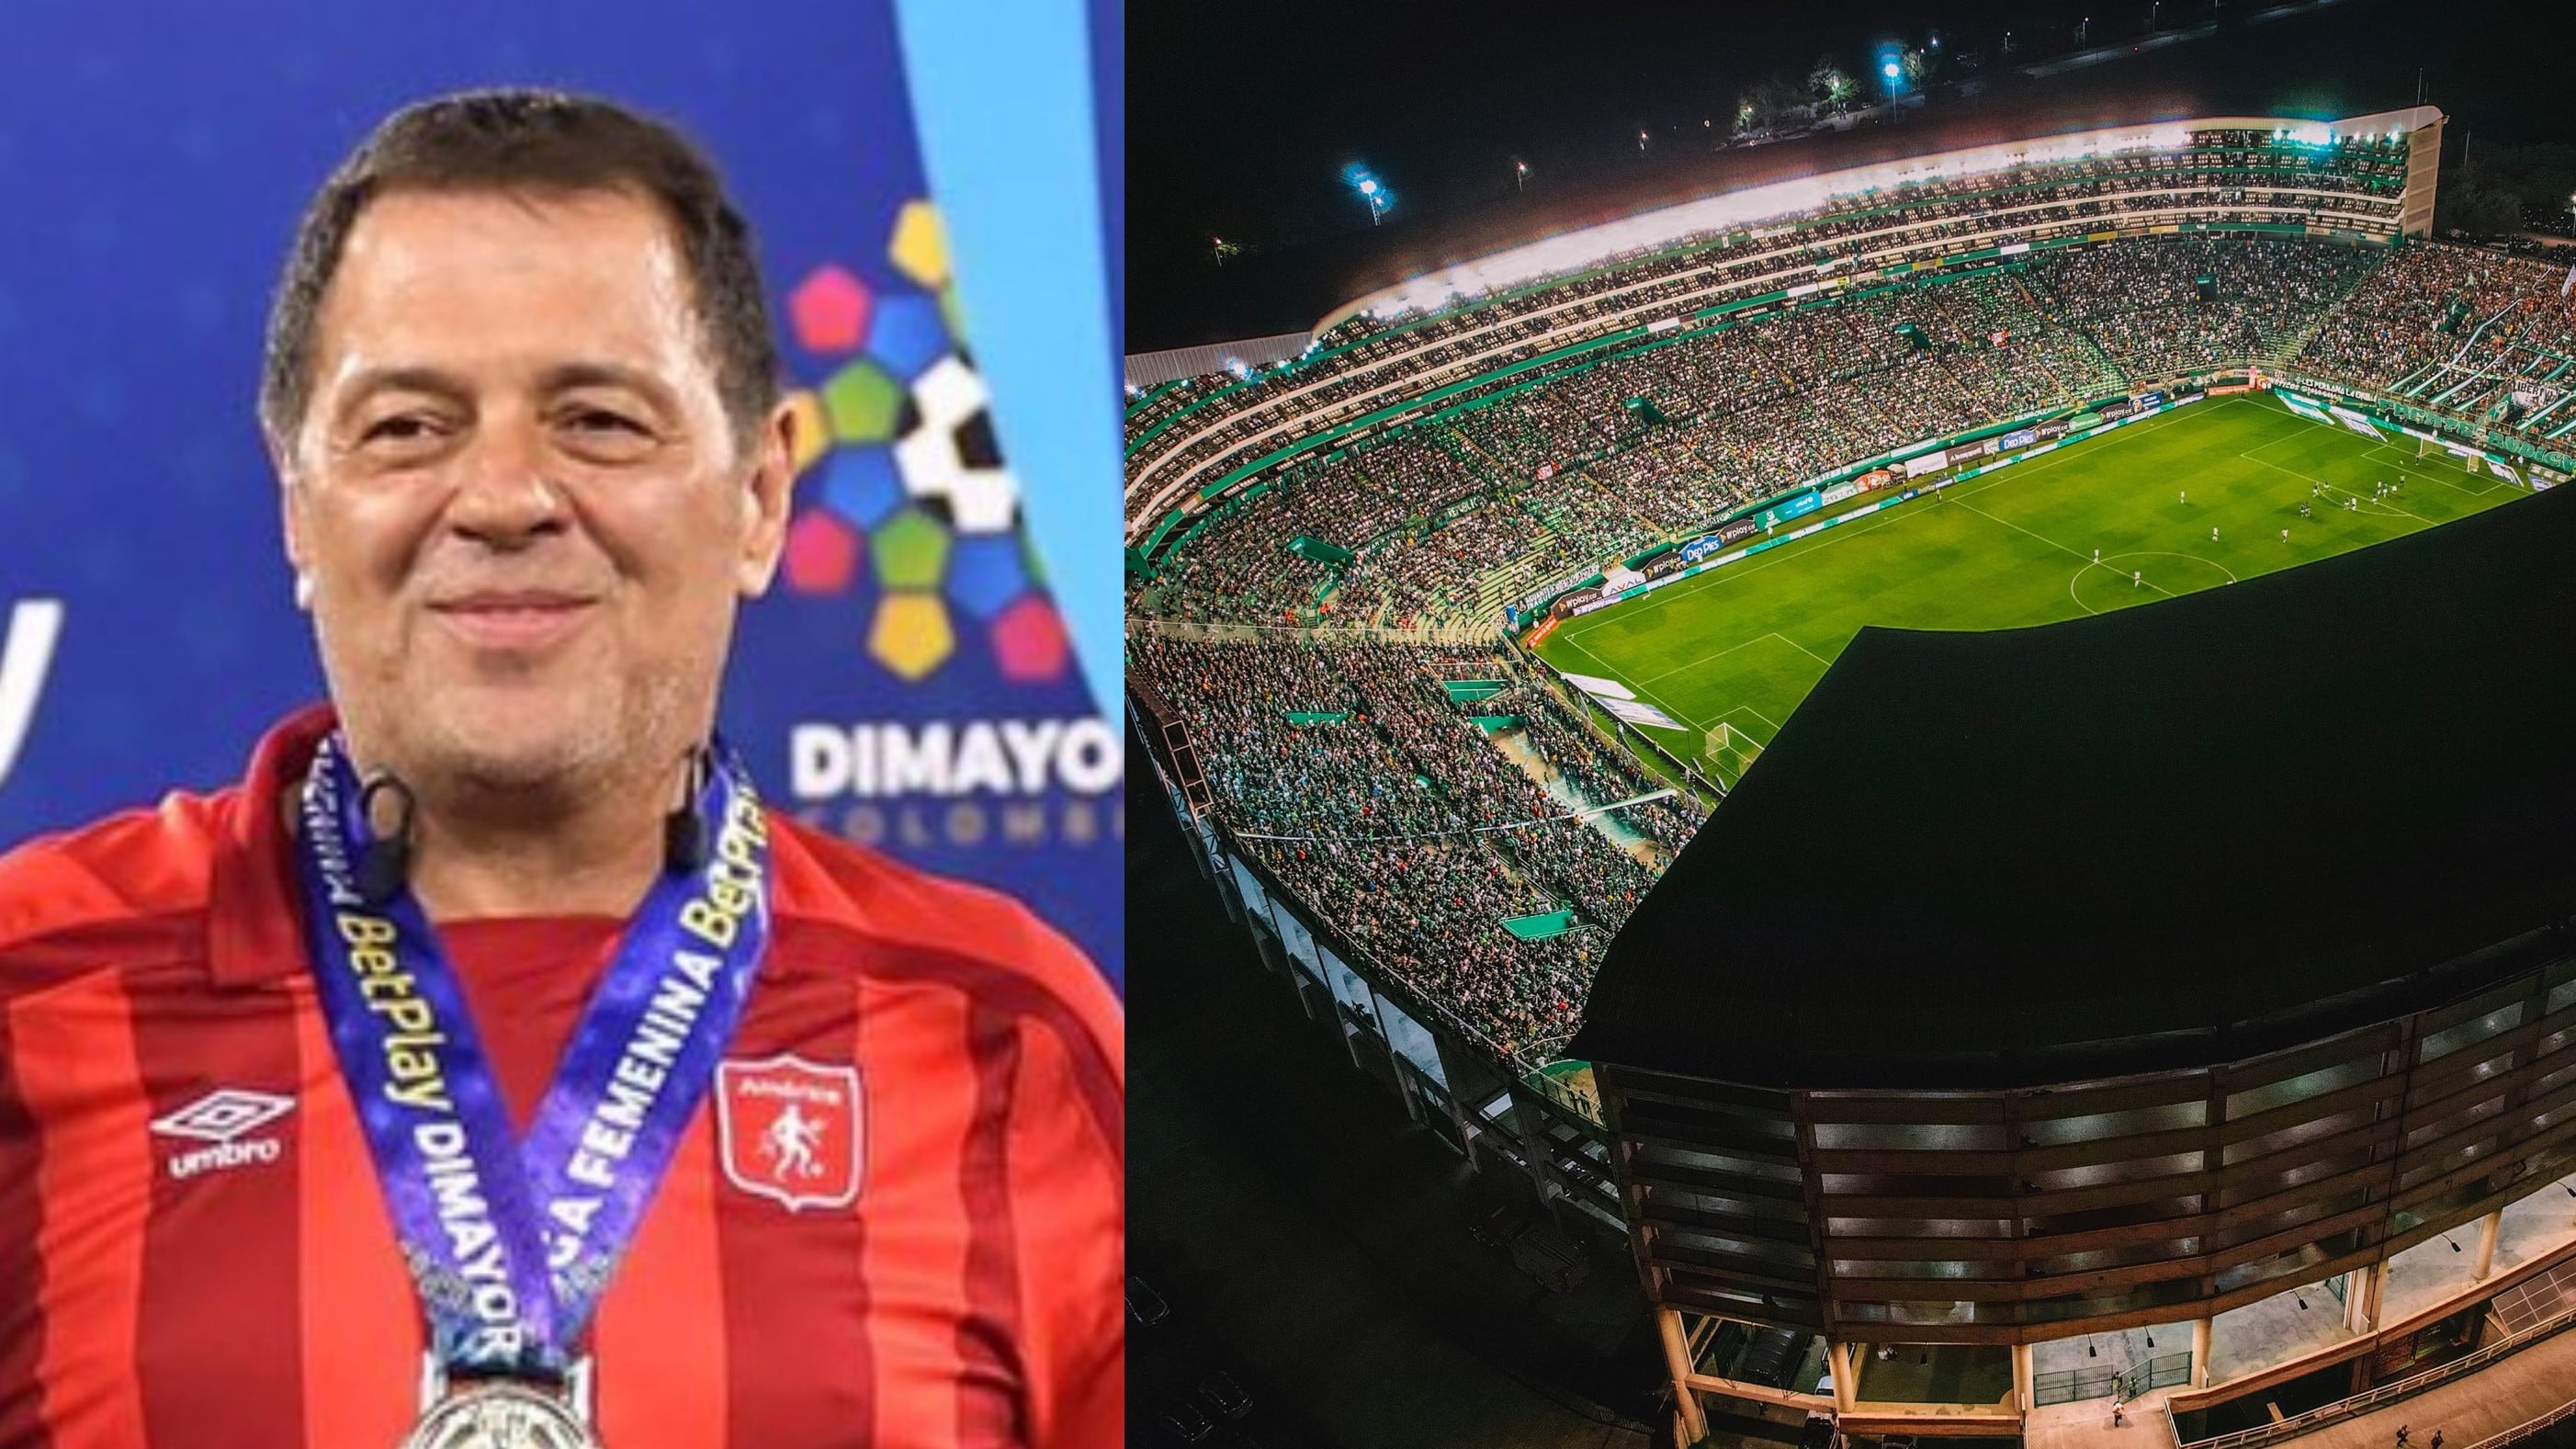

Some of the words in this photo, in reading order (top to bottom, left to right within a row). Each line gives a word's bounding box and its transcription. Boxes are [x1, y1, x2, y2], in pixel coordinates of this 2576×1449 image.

[168, 1138, 281, 1180] umbro
[335, 912, 454, 1112] BetPlay
[414, 1123, 523, 1362] DIMAYOR
[567, 949, 724, 1188] FEMENINA
